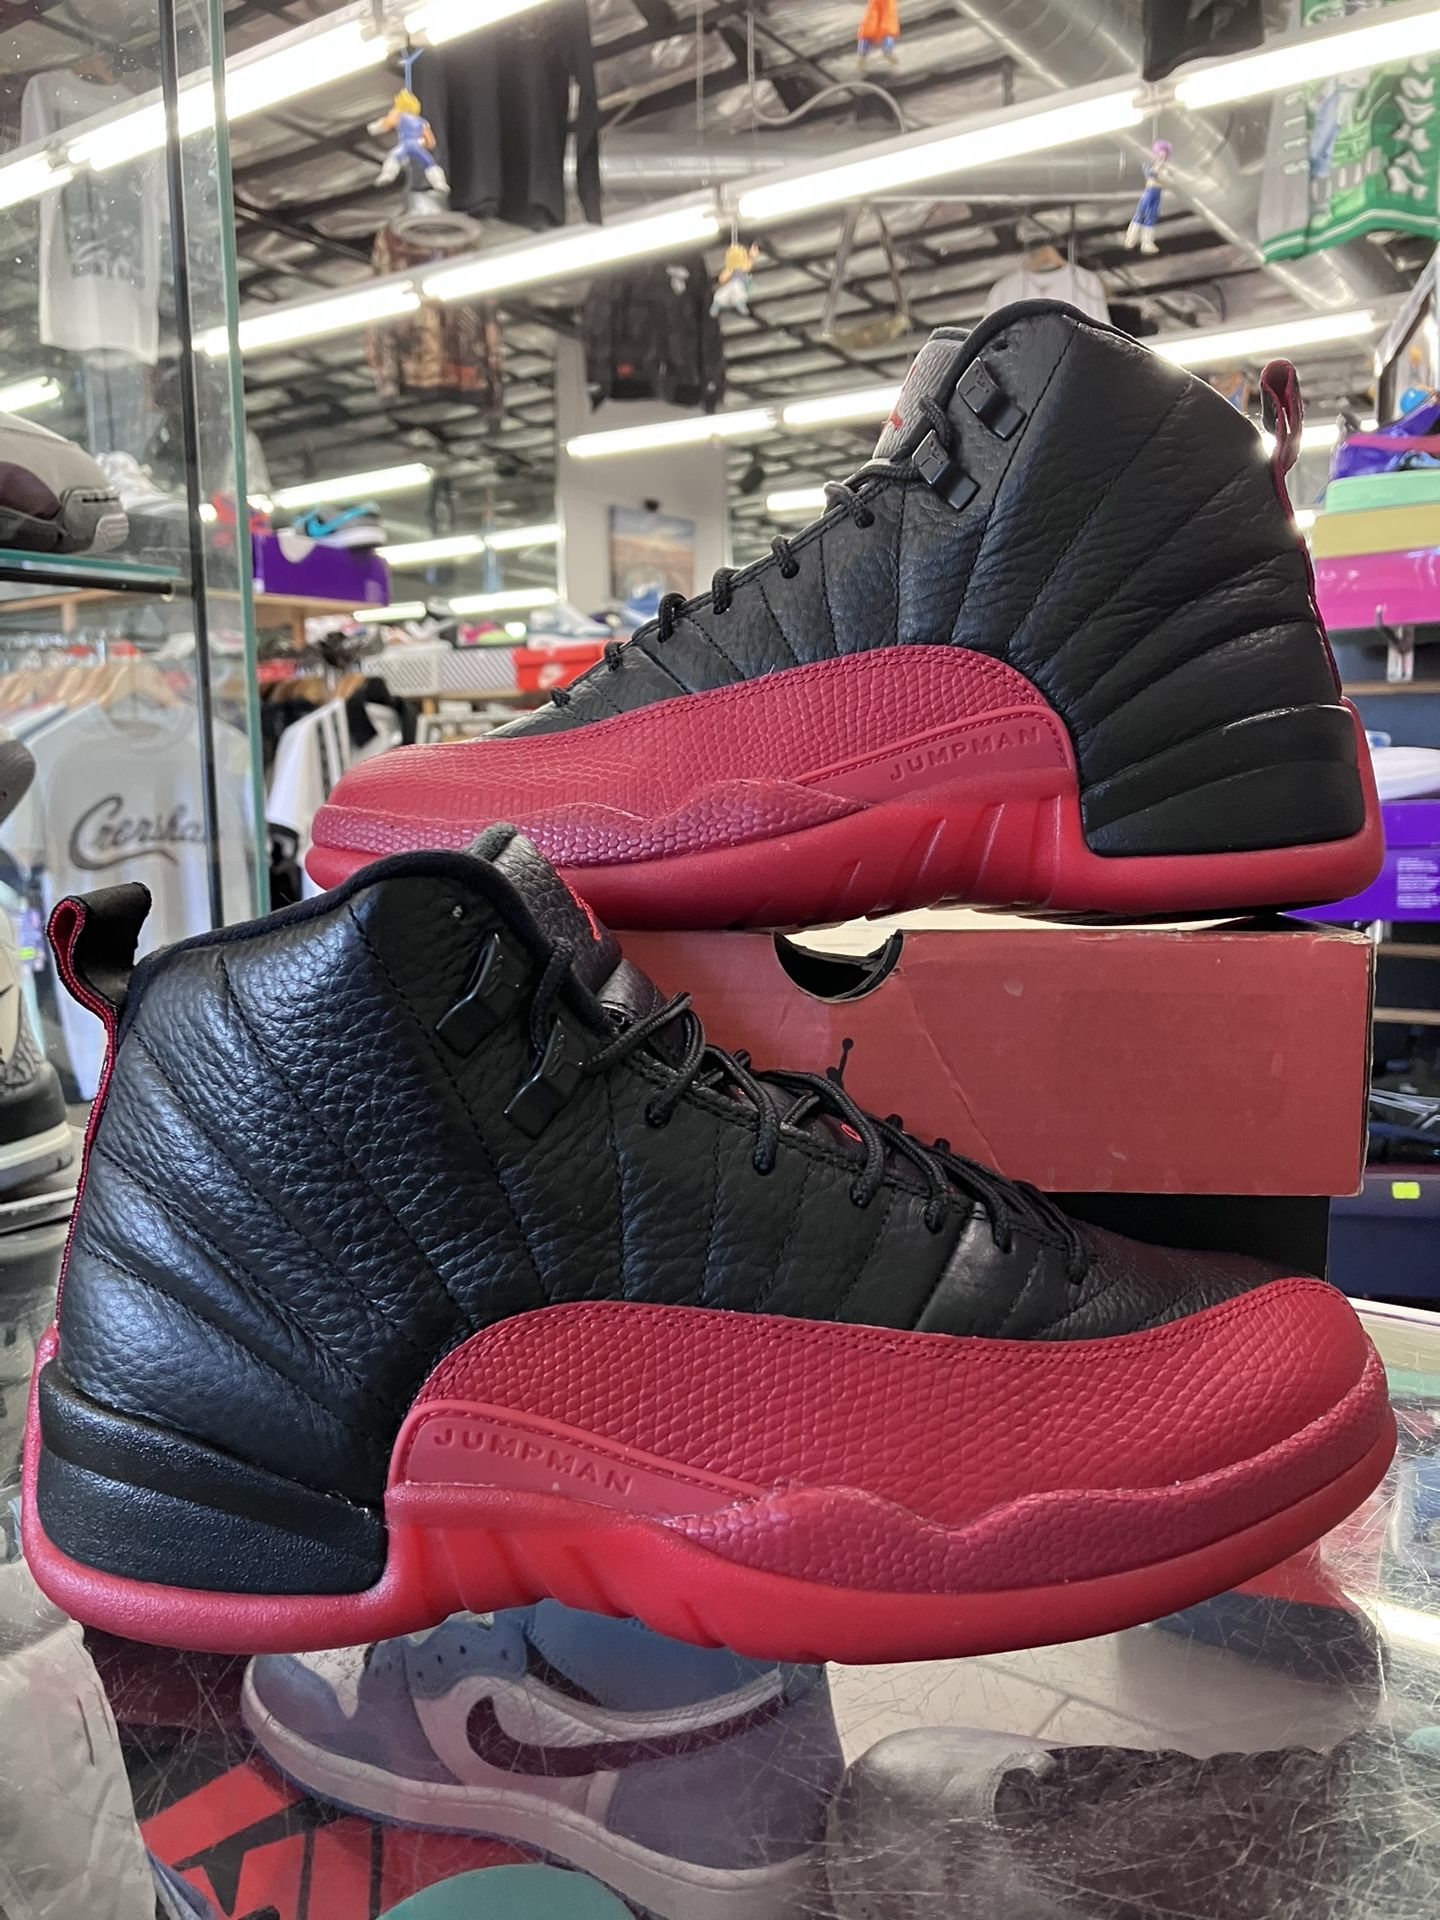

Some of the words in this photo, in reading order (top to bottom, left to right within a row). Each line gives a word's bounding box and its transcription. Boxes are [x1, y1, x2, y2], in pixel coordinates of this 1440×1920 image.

[889, 726, 1040, 781] JUMPMAN
[69, 795, 207, 871] Crensha
[433, 1428, 633, 1496] JUMPMAN
